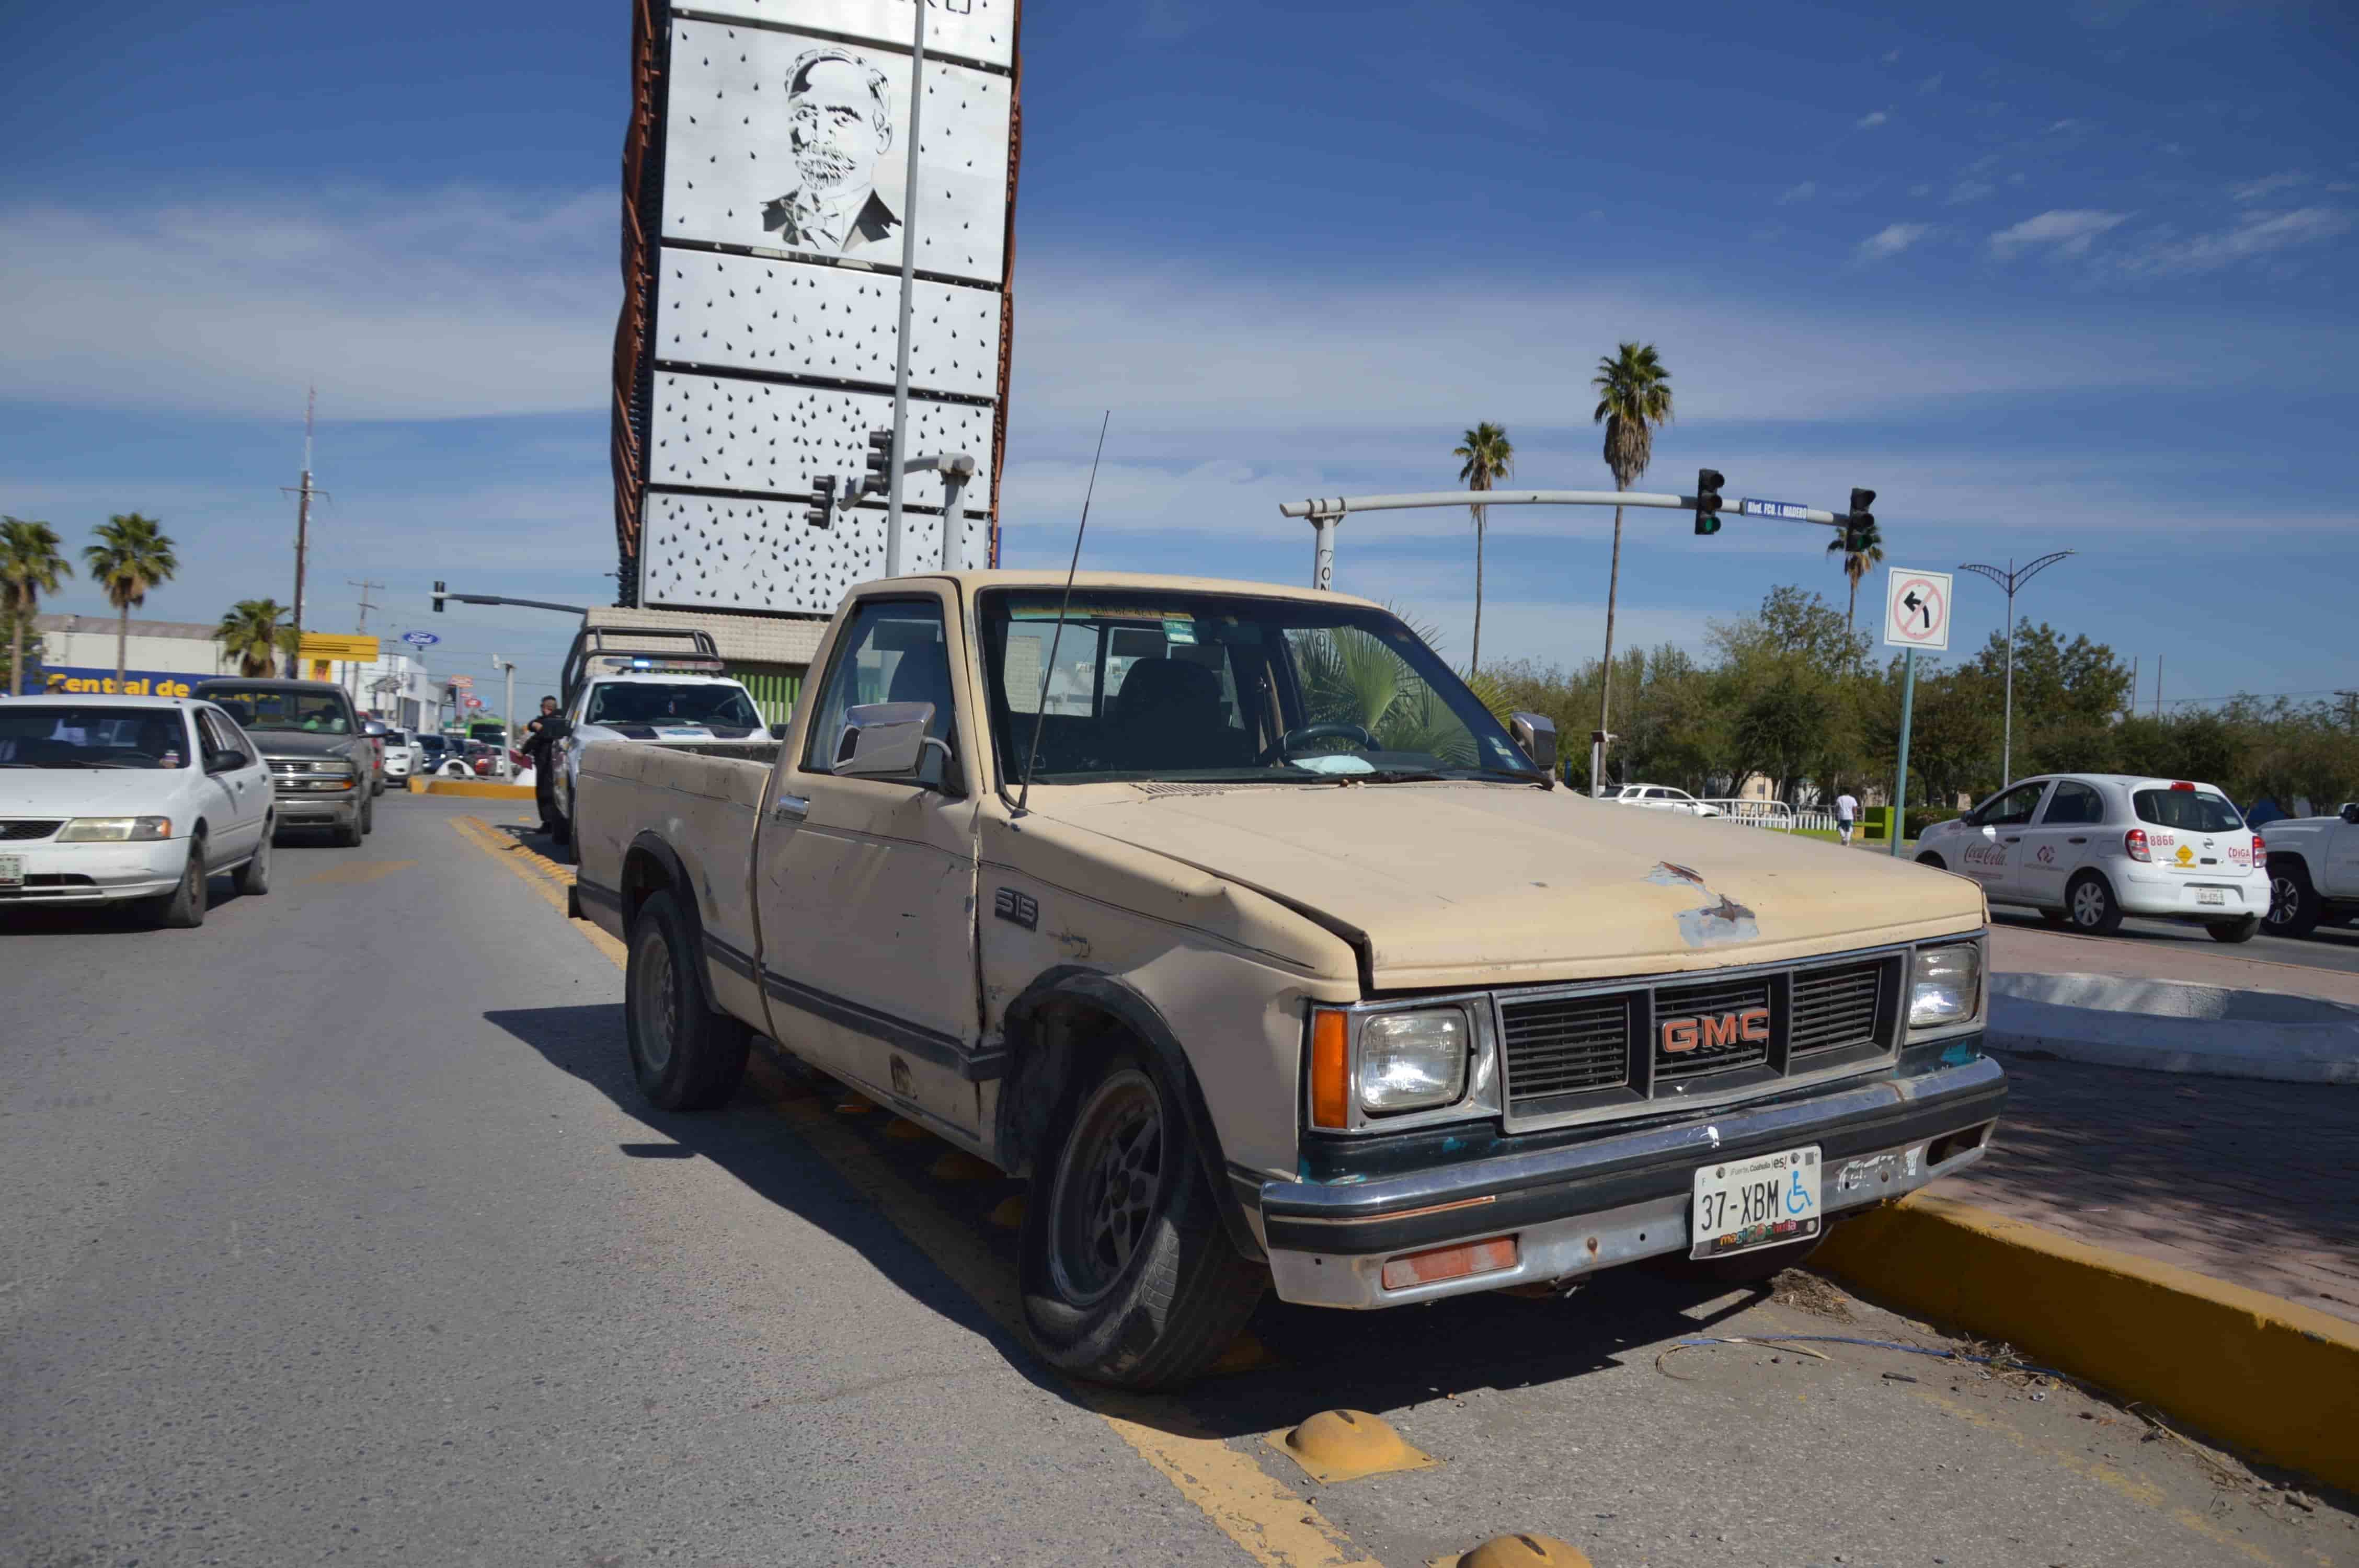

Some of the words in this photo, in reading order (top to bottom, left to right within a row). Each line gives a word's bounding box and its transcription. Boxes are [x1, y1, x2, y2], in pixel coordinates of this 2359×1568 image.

[1764, 503, 1777, 515] FCO.
[1782, 505, 1807, 518] MADERO
[47, 673, 150, 695] Cental
[155, 681, 190, 697] de
[2150, 835, 2174, 846] 8866
[1663, 1008, 1769, 1053] GMC
[1701, 1179, 1779, 1231] 37-XBM
